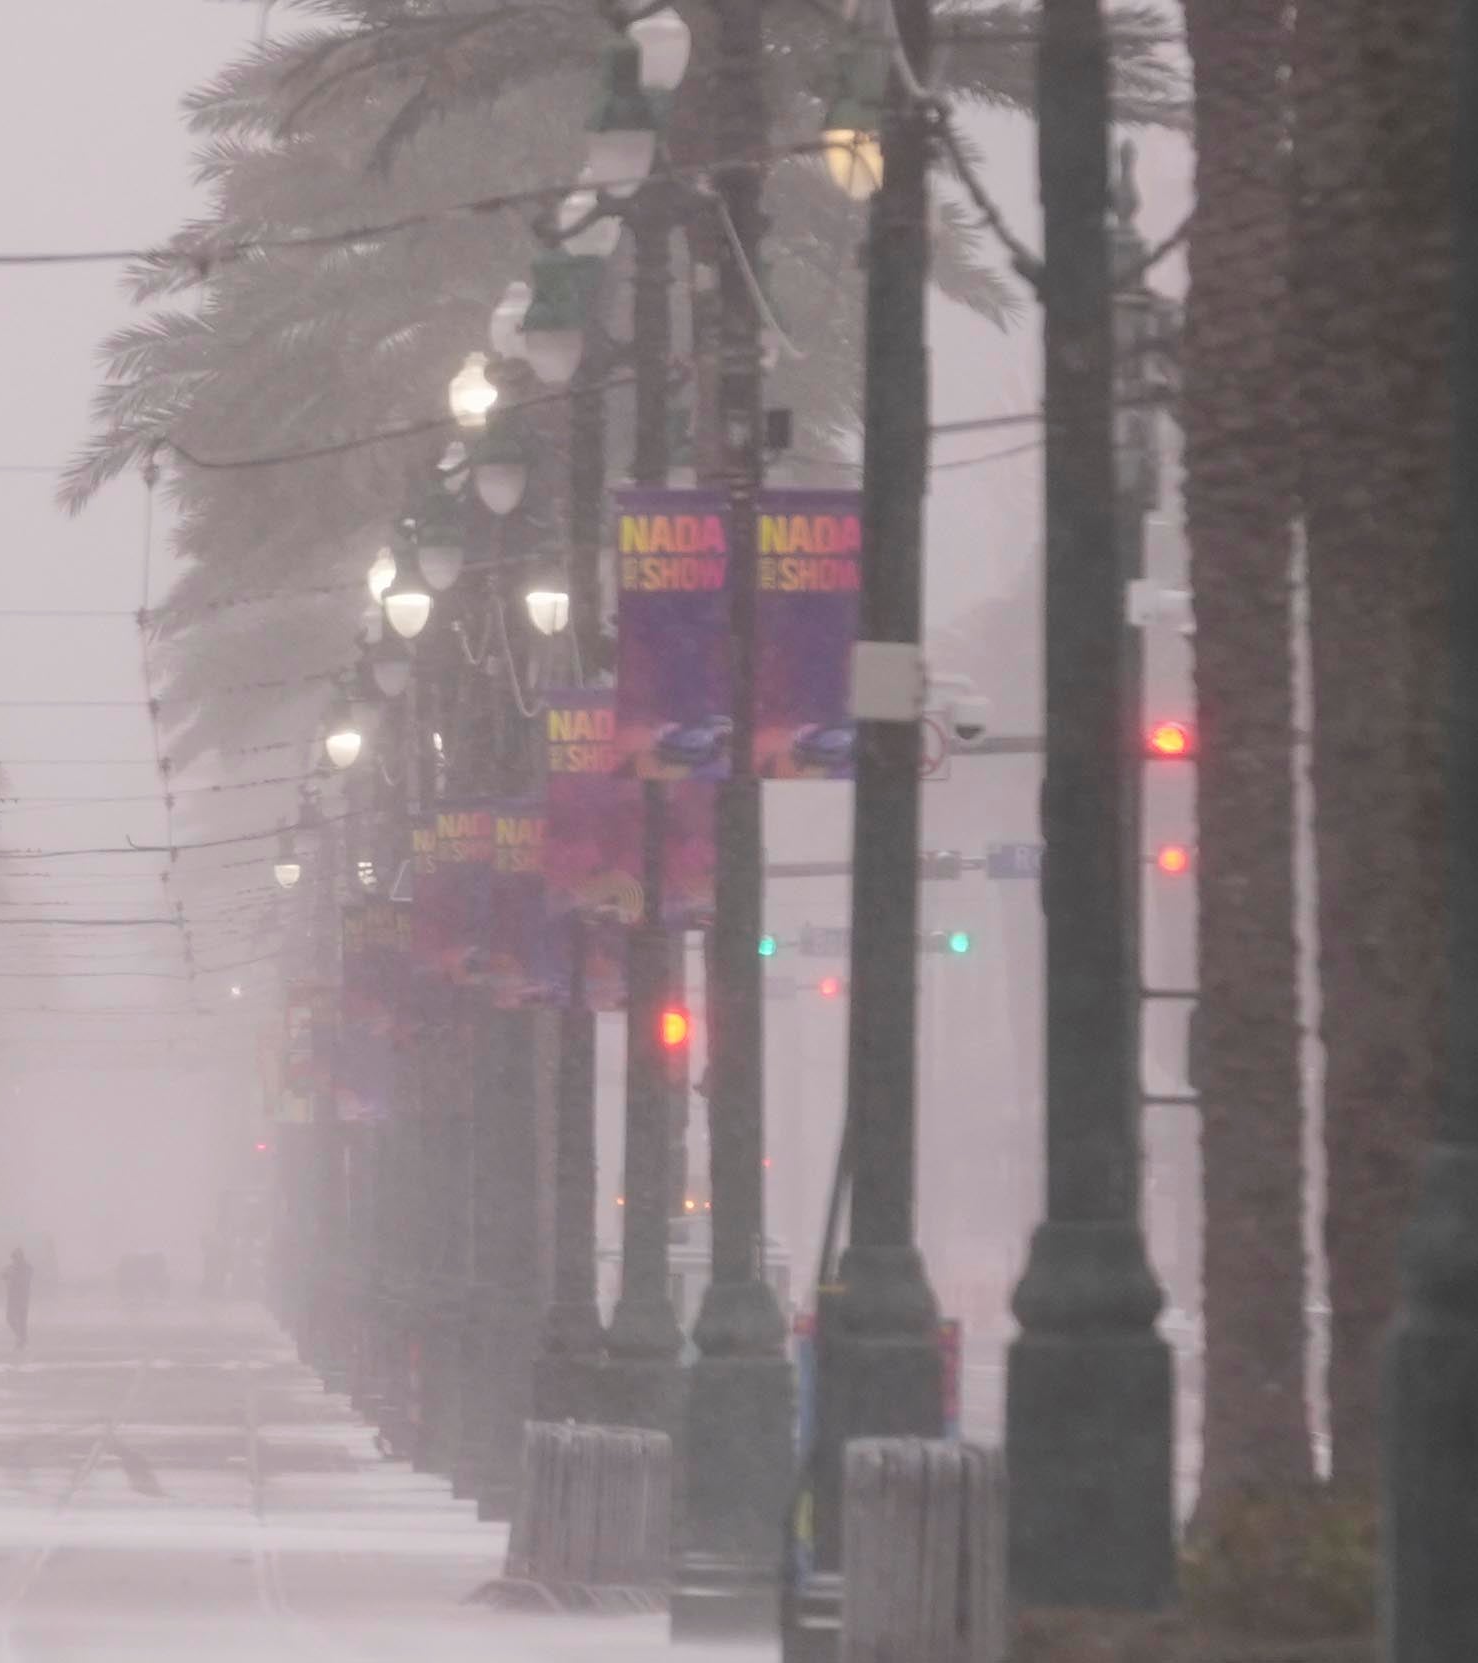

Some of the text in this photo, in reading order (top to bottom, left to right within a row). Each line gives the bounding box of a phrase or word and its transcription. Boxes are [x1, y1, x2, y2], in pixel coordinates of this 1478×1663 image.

[619, 515, 727, 553] NADA
[757, 515, 862, 553] NADA
[643, 557, 728, 591] SHOW
[548, 709, 616, 741] NAD
[568, 745, 616, 773] SHO
